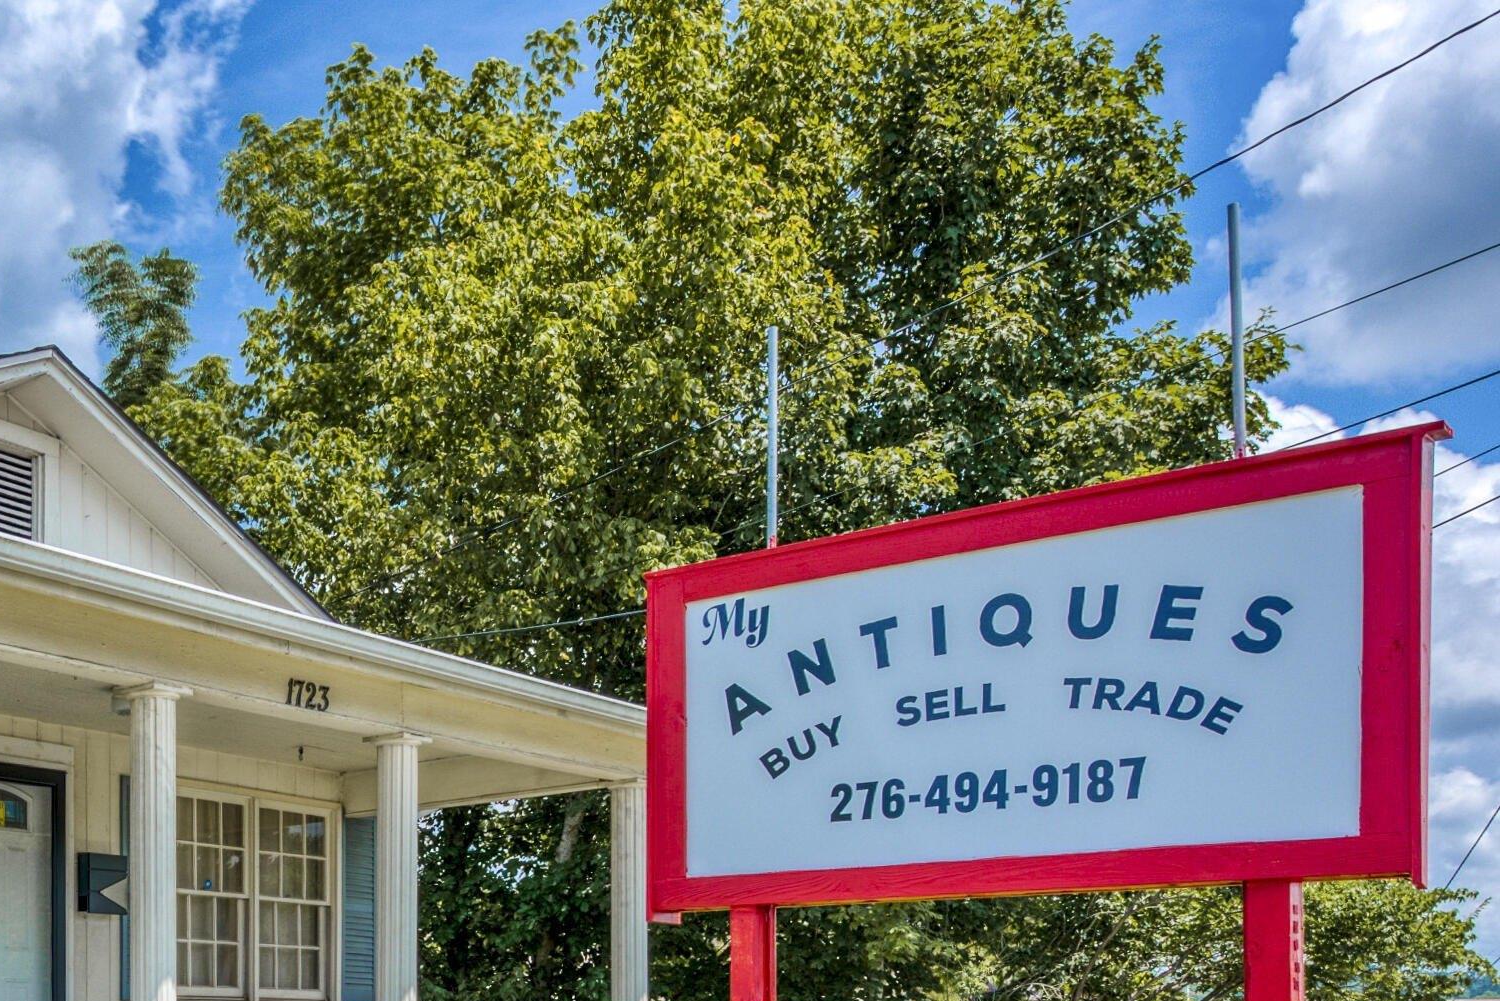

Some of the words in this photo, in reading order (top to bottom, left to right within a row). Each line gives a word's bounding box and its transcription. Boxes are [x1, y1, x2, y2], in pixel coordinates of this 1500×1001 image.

[702, 597, 770, 650] My
[724, 584, 1294, 736] ANTIQUES
[285, 677, 330, 712] 1723
[759, 714, 842, 780] BUY
[896, 682, 1006, 727] SELL
[1063, 677, 1244, 736] TRADE
[830, 756, 1147, 823] 276-494-9187
